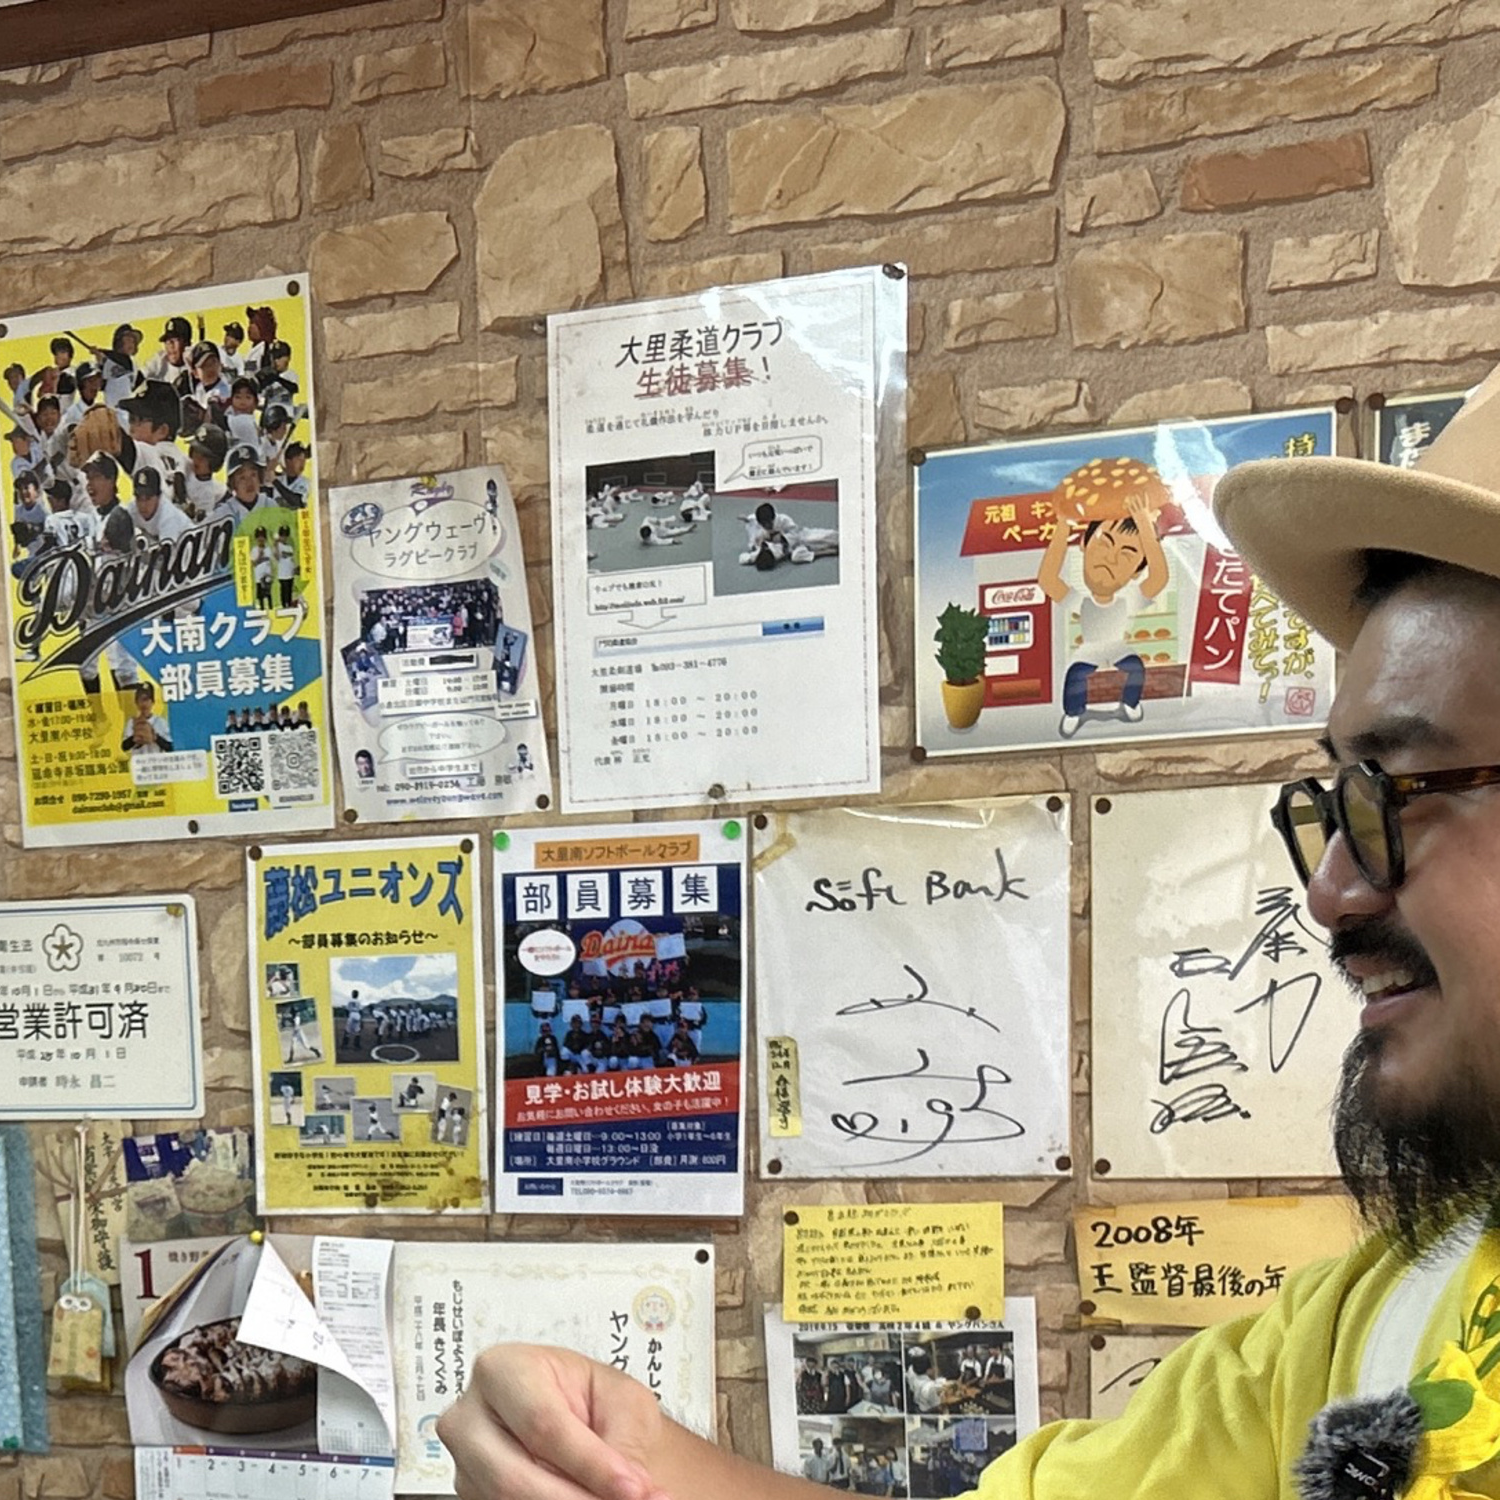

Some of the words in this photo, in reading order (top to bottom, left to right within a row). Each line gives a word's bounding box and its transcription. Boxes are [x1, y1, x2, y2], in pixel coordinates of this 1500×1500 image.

[615, 316, 784, 368] 大里柔道クラブ
[634, 356, 772, 399] 生徒募集！
[984, 503, 1016, 524] 元祖
[384, 541, 479, 568] ラグビークラブ
[14, 515, 236, 648] Dainan
[159, 652, 295, 703] 部員募集
[522, 872, 710, 915] 部員募集
[926, 846, 1029, 906] Bank
[263, 855, 464, 941] 藤松ユニオンズ
[580, 930, 658, 961] Daina
[524, 1070, 723, 1106] 見学・お試し体験大歓迎
[1090, 1215, 1205, 1248] 2008年
[134, 1248, 161, 1299] 1
[433, 1301, 447, 1333] 年長
[647, 1338, 662, 1400] かんし
[208, 1459, 214, 1470] 2
[239, 1461, 245, 1472] 3
[269, 1463, 275, 1474] 4
[299, 1465, 306, 1476] 5
[330, 1467, 337, 1478] 6
[361, 1469, 369, 1479] 7
